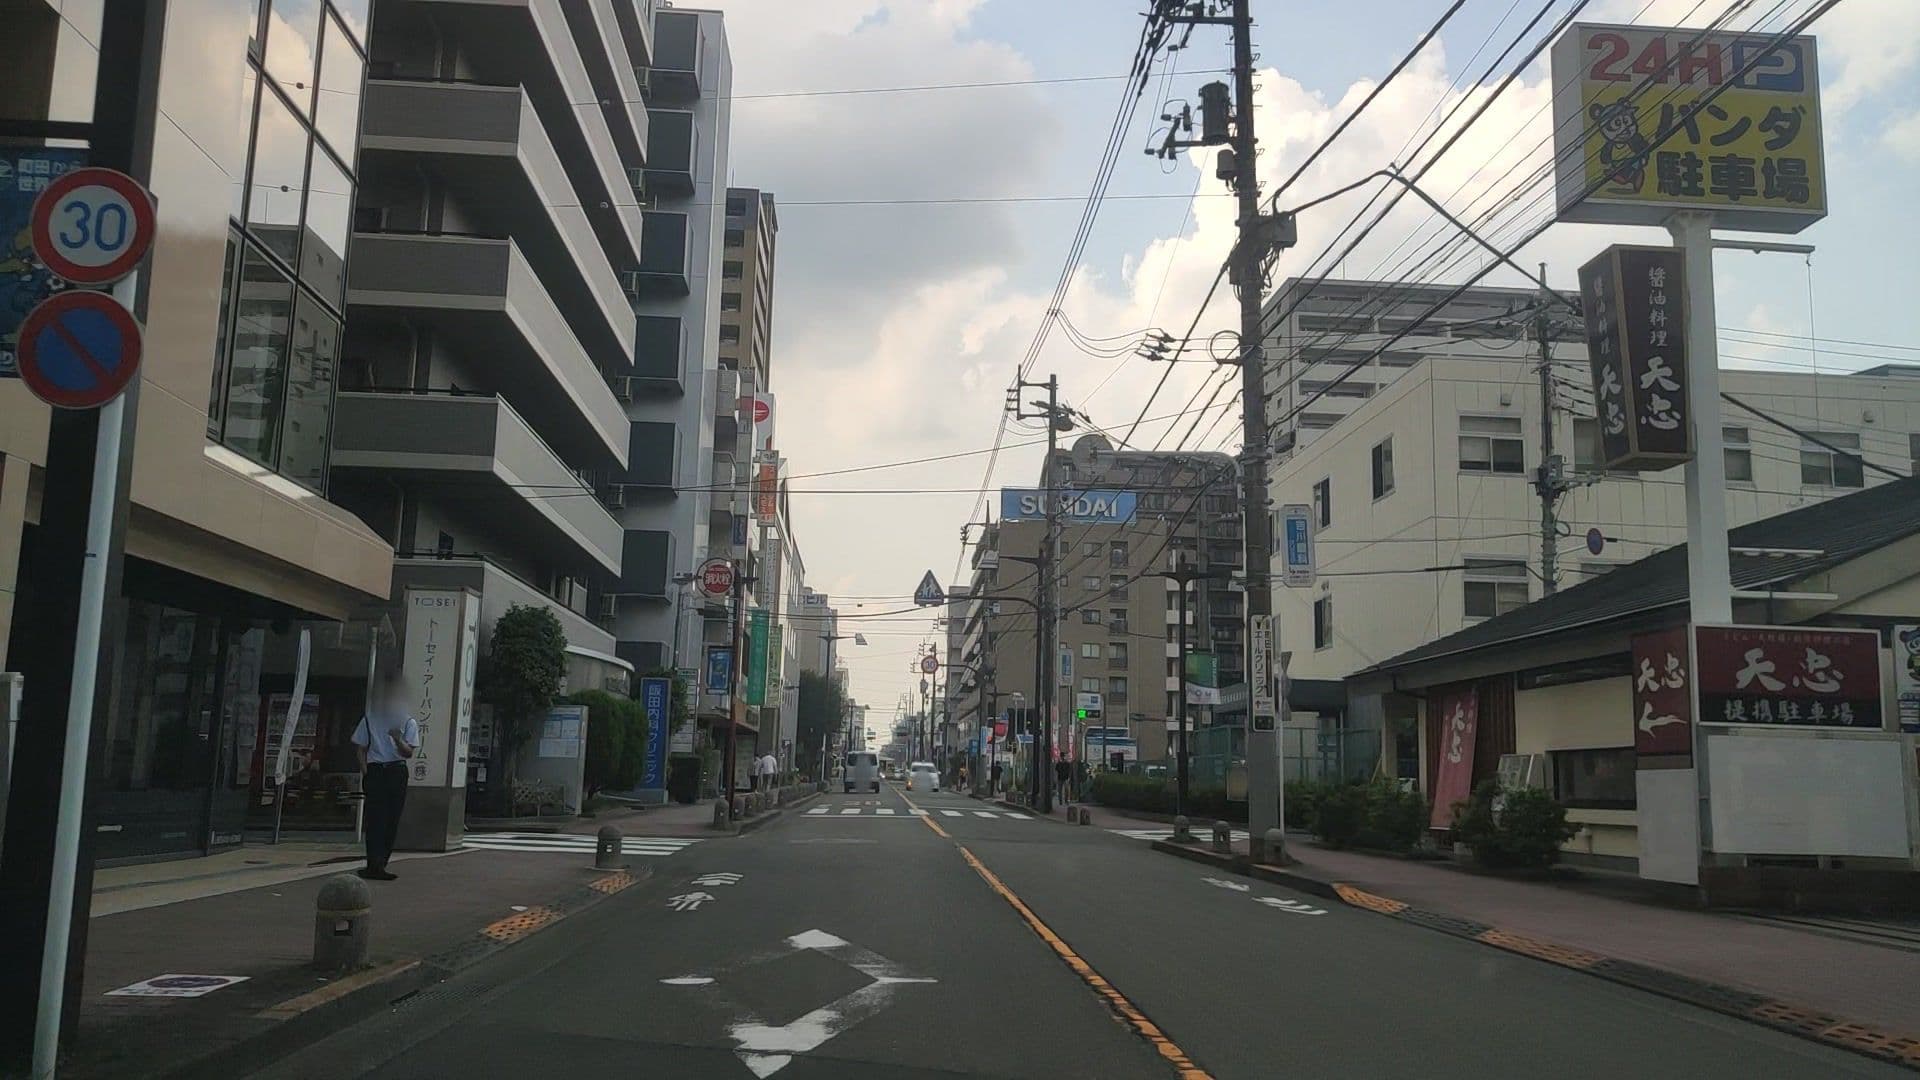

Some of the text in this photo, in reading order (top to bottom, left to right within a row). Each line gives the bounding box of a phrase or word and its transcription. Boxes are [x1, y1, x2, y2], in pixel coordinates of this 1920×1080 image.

[1588, 32, 1723, 86] 24H
[1656, 151, 1810, 204] 駐車場
[60, 200, 127, 252] 30
[704, 572, 731, 585] 消火栓
[415, 597, 456, 607] TOSEI
[1723, 698, 1856, 726] 提携駐車場
